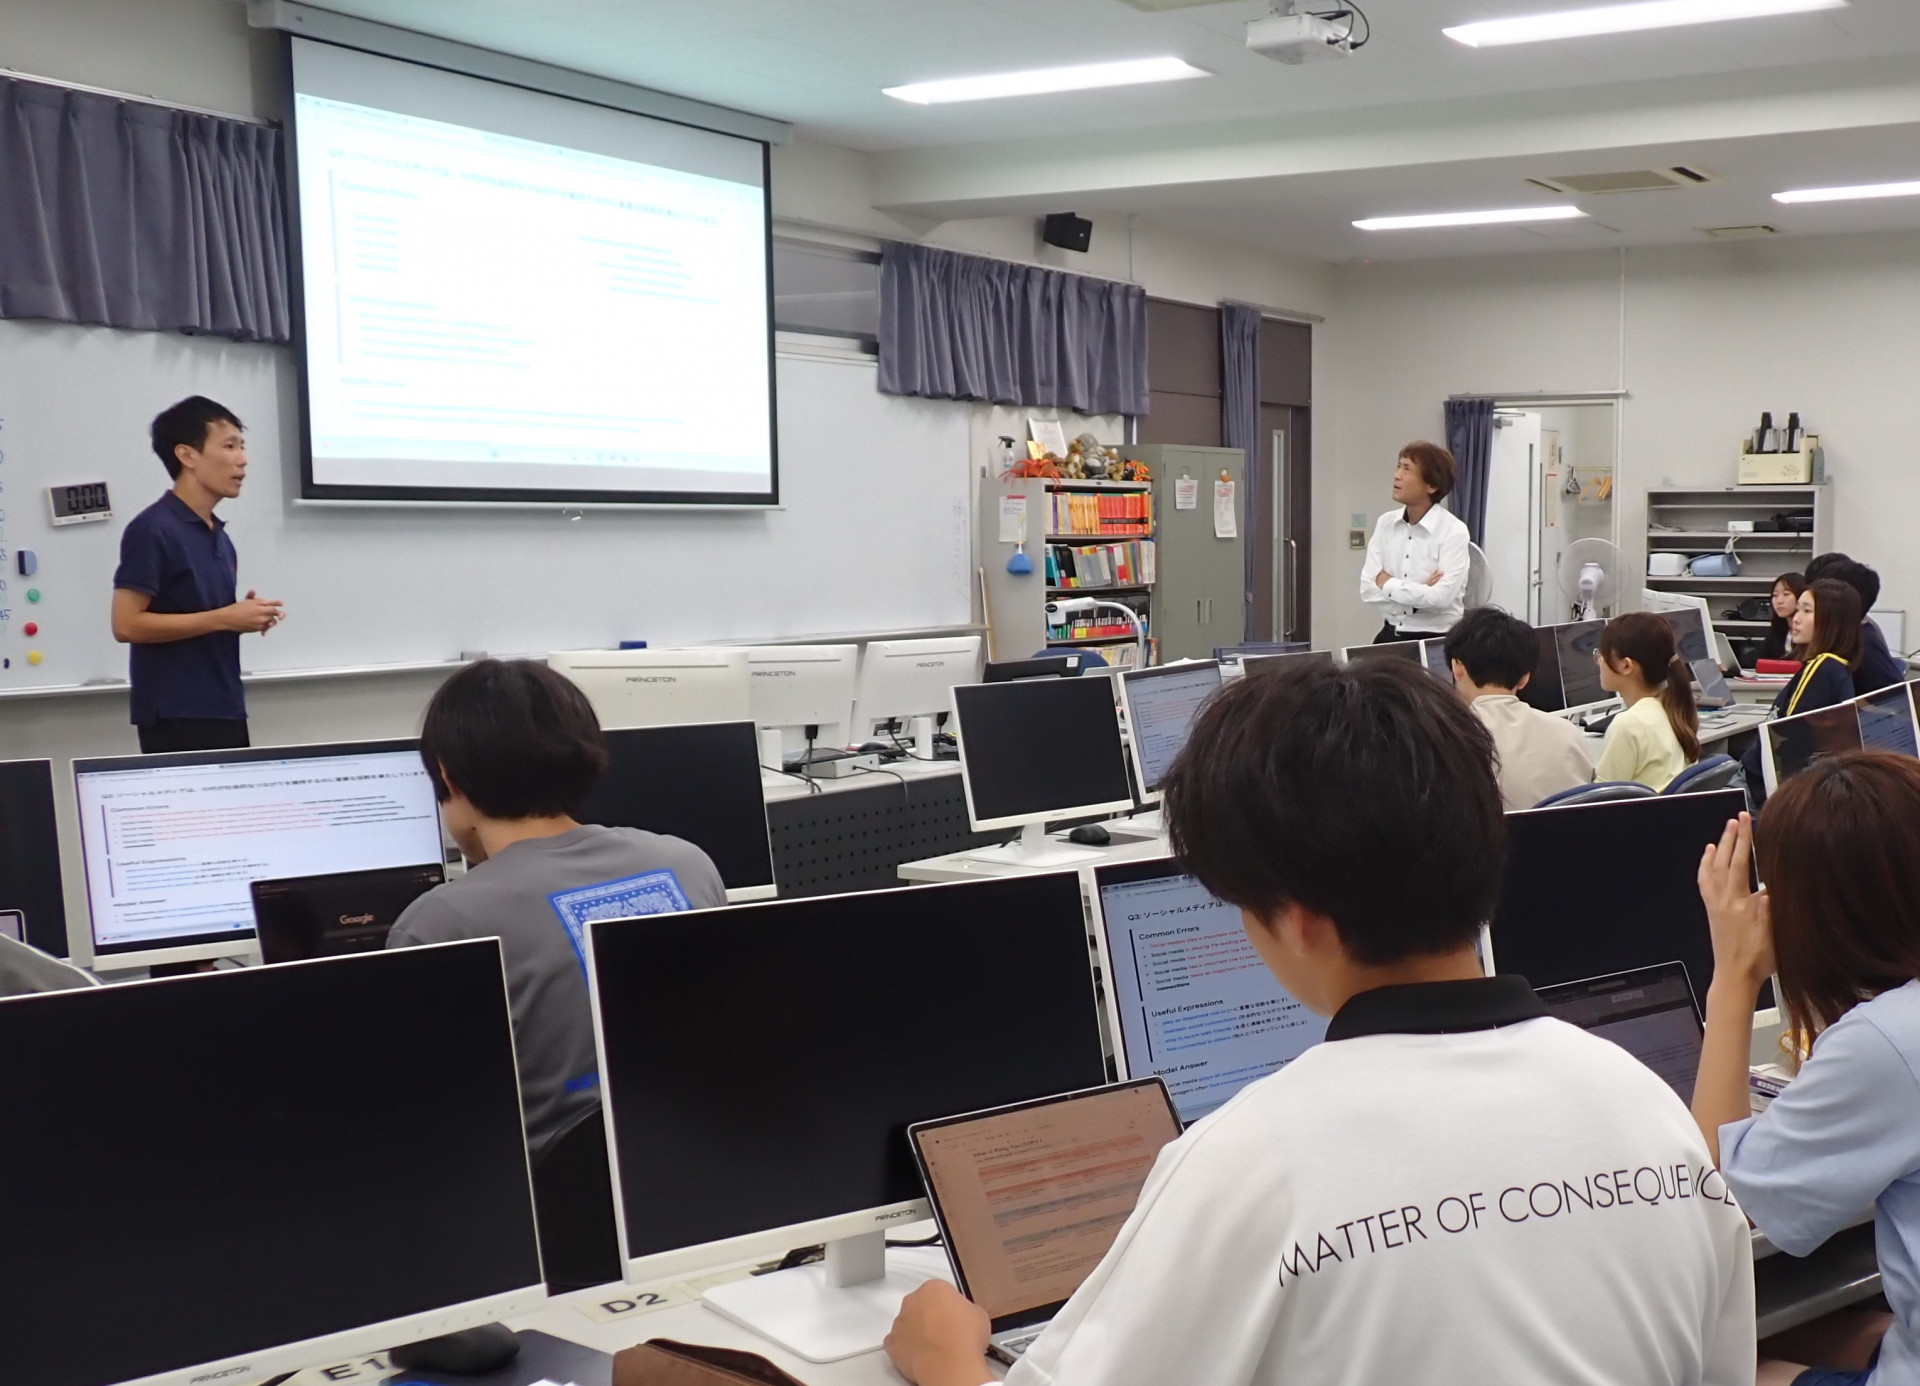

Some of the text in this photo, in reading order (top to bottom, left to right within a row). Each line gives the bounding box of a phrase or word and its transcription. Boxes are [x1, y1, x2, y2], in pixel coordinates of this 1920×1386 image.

[751, 669, 796, 678] PRINCETON
[339, 912, 374, 925] Google
[1128, 913, 1141, 921] Q3:
[1139, 926, 1200, 940] Common Errors
[1151, 999, 1224, 1018] Useful Expressions
[1153, 1060, 1208, 1076] Model Answer
[874, 1208, 917, 1222] PRINCETON
[1278, 1205, 1428, 1288] MATTER
[1436, 1192, 1487, 1233] OF
[601, 1292, 668, 1314] D2
[321, 1356, 387, 1382] E1
